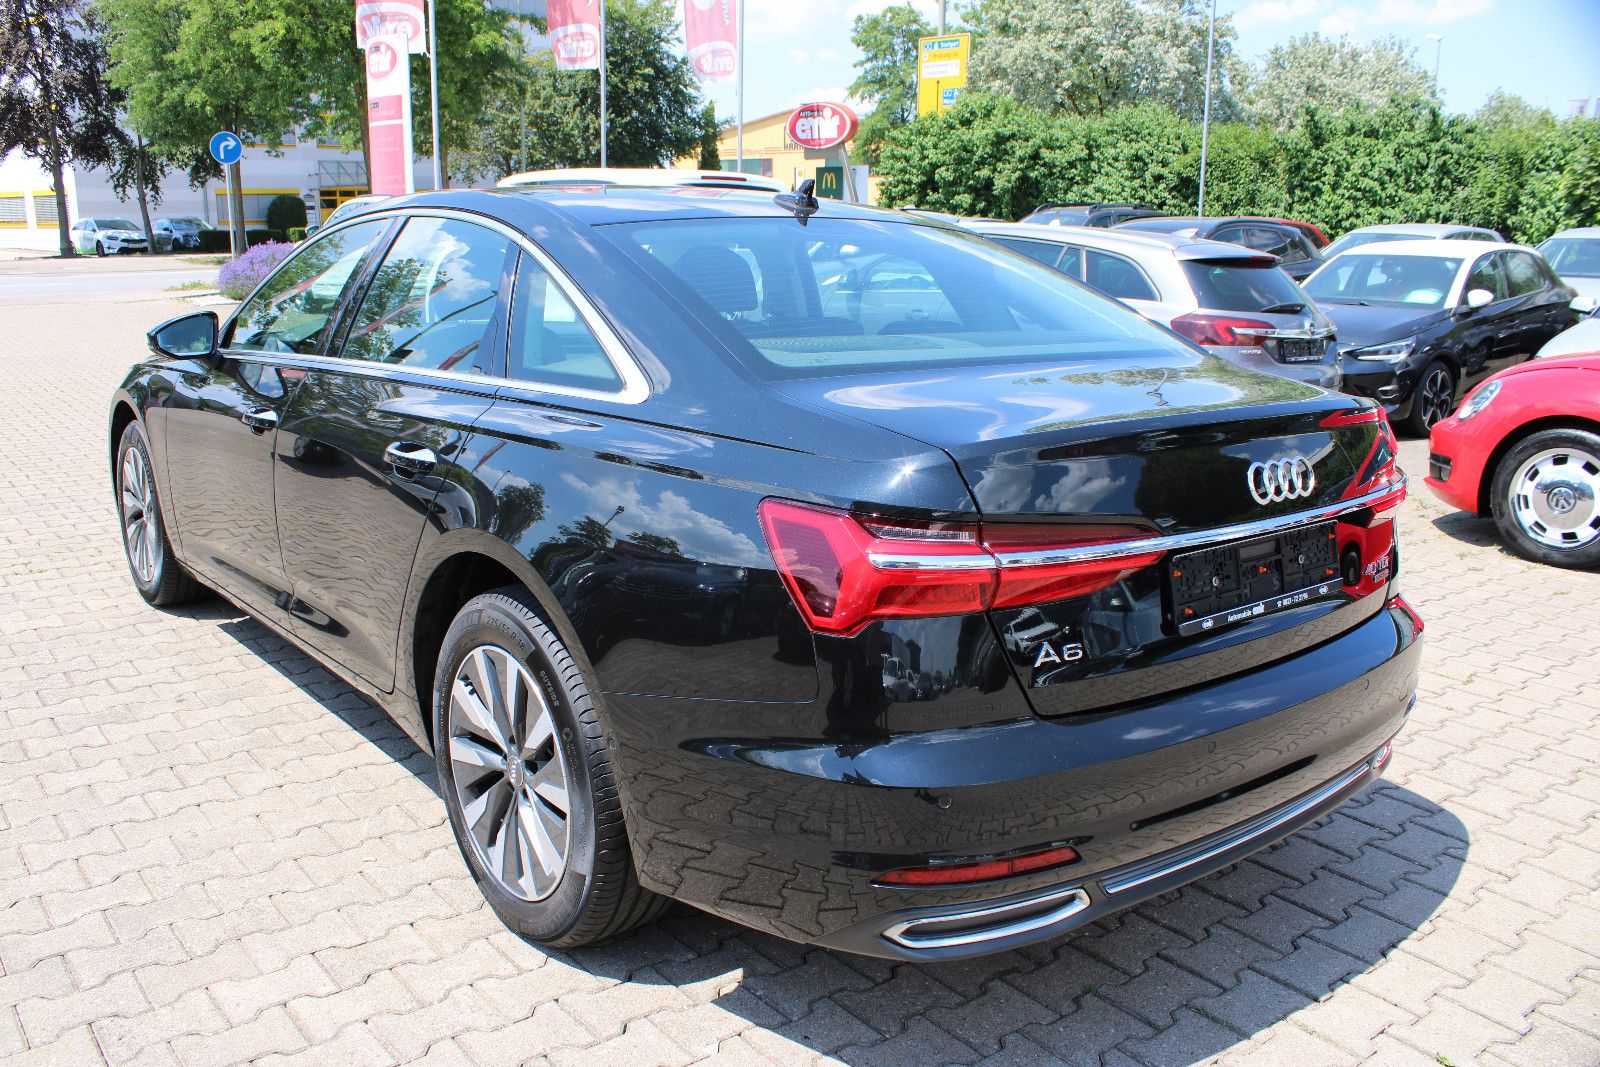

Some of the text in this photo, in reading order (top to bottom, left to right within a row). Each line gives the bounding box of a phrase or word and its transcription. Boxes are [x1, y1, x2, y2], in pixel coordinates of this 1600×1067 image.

[796, 107, 840, 139] emir
[1228, 608, 1252, 622] Automobile
[487, 616, 511, 635] 225/55
[510, 631, 517, 641] R
[518, 639, 526, 651] 18
[1034, 641, 1083, 668] A6
[540, 670, 559, 707] OUTSIDE
